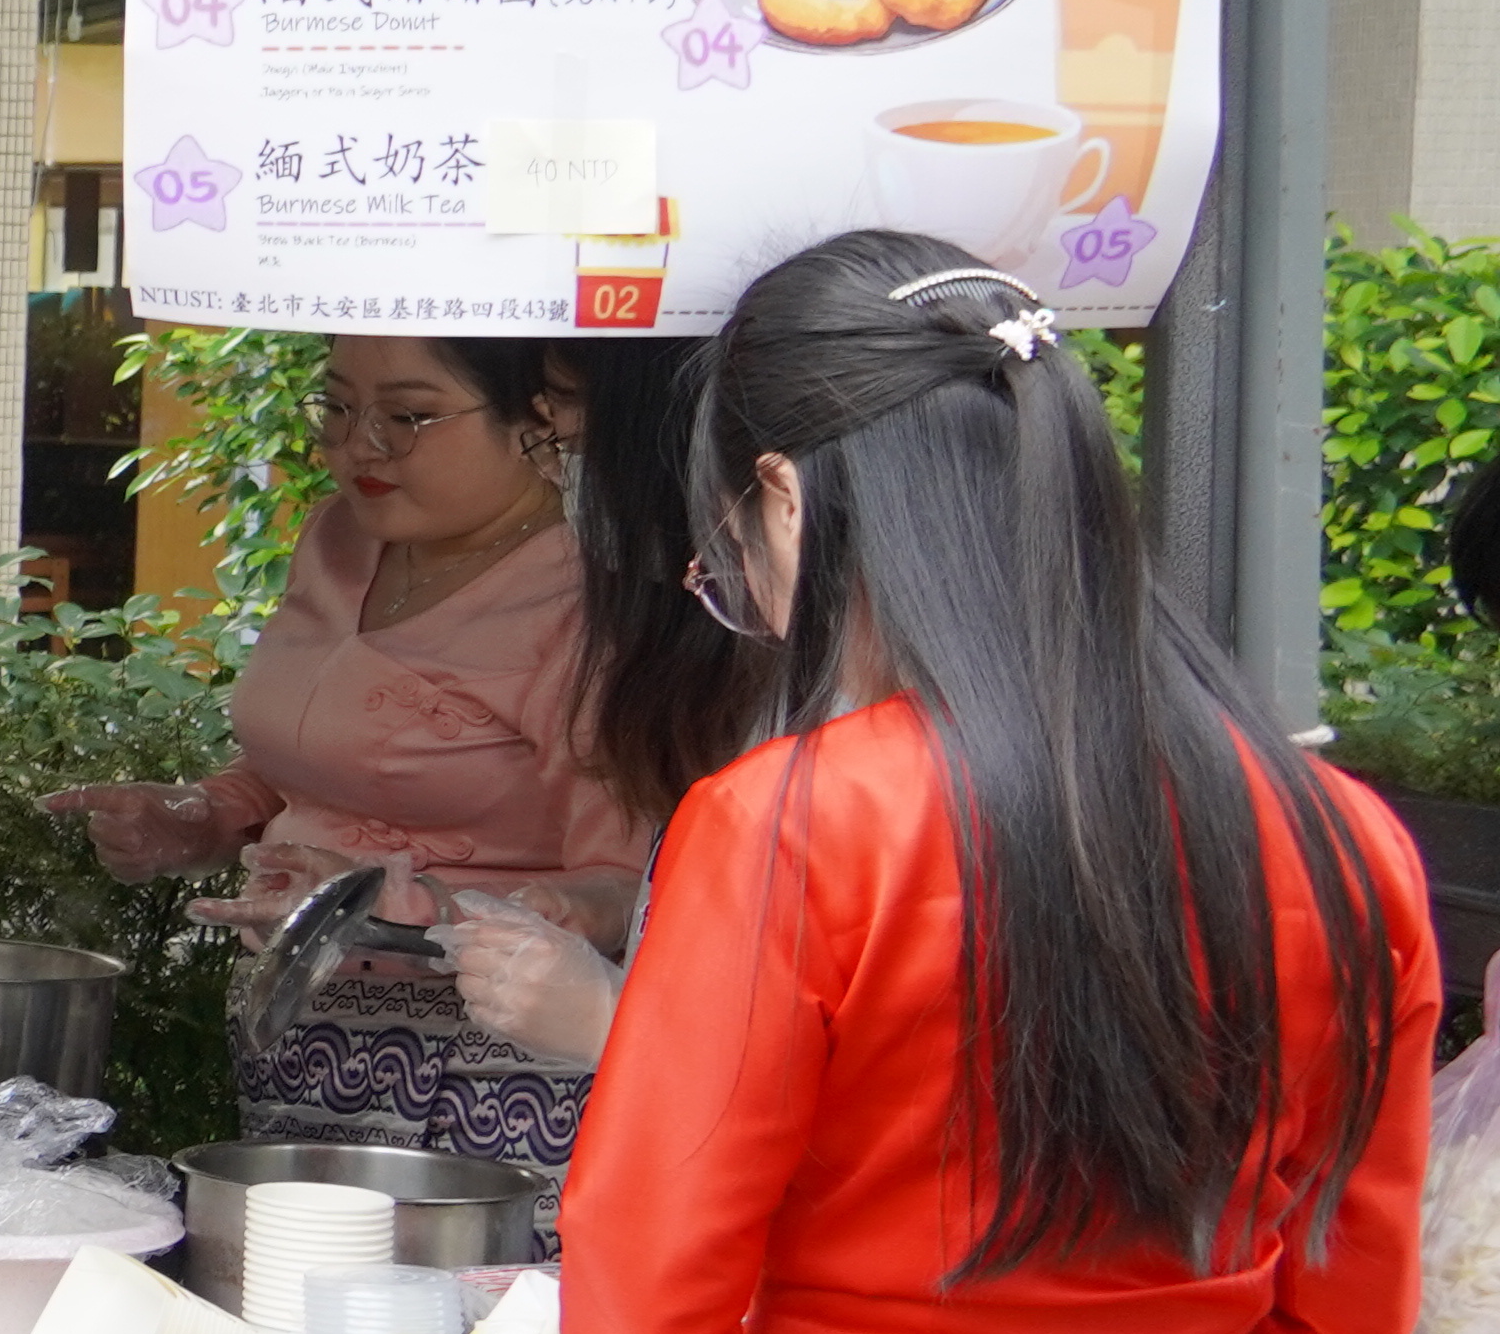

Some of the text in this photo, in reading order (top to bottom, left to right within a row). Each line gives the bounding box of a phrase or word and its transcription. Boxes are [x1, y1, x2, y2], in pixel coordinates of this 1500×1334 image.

[262, 11, 441, 33] Burmese Donut
[682, 24, 743, 68] 04
[255, 133, 487, 188] 緬式奶茶
[526, 158, 620, 188] 40 NTD
[152, 169, 219, 205] 05
[257, 192, 466, 216] Burmese Milk Tea
[1073, 226, 1132, 263] 05
[139, 285, 570, 323] NTUST: 臺北市大安區基隆路四段43號
[593, 284, 640, 320] 02
